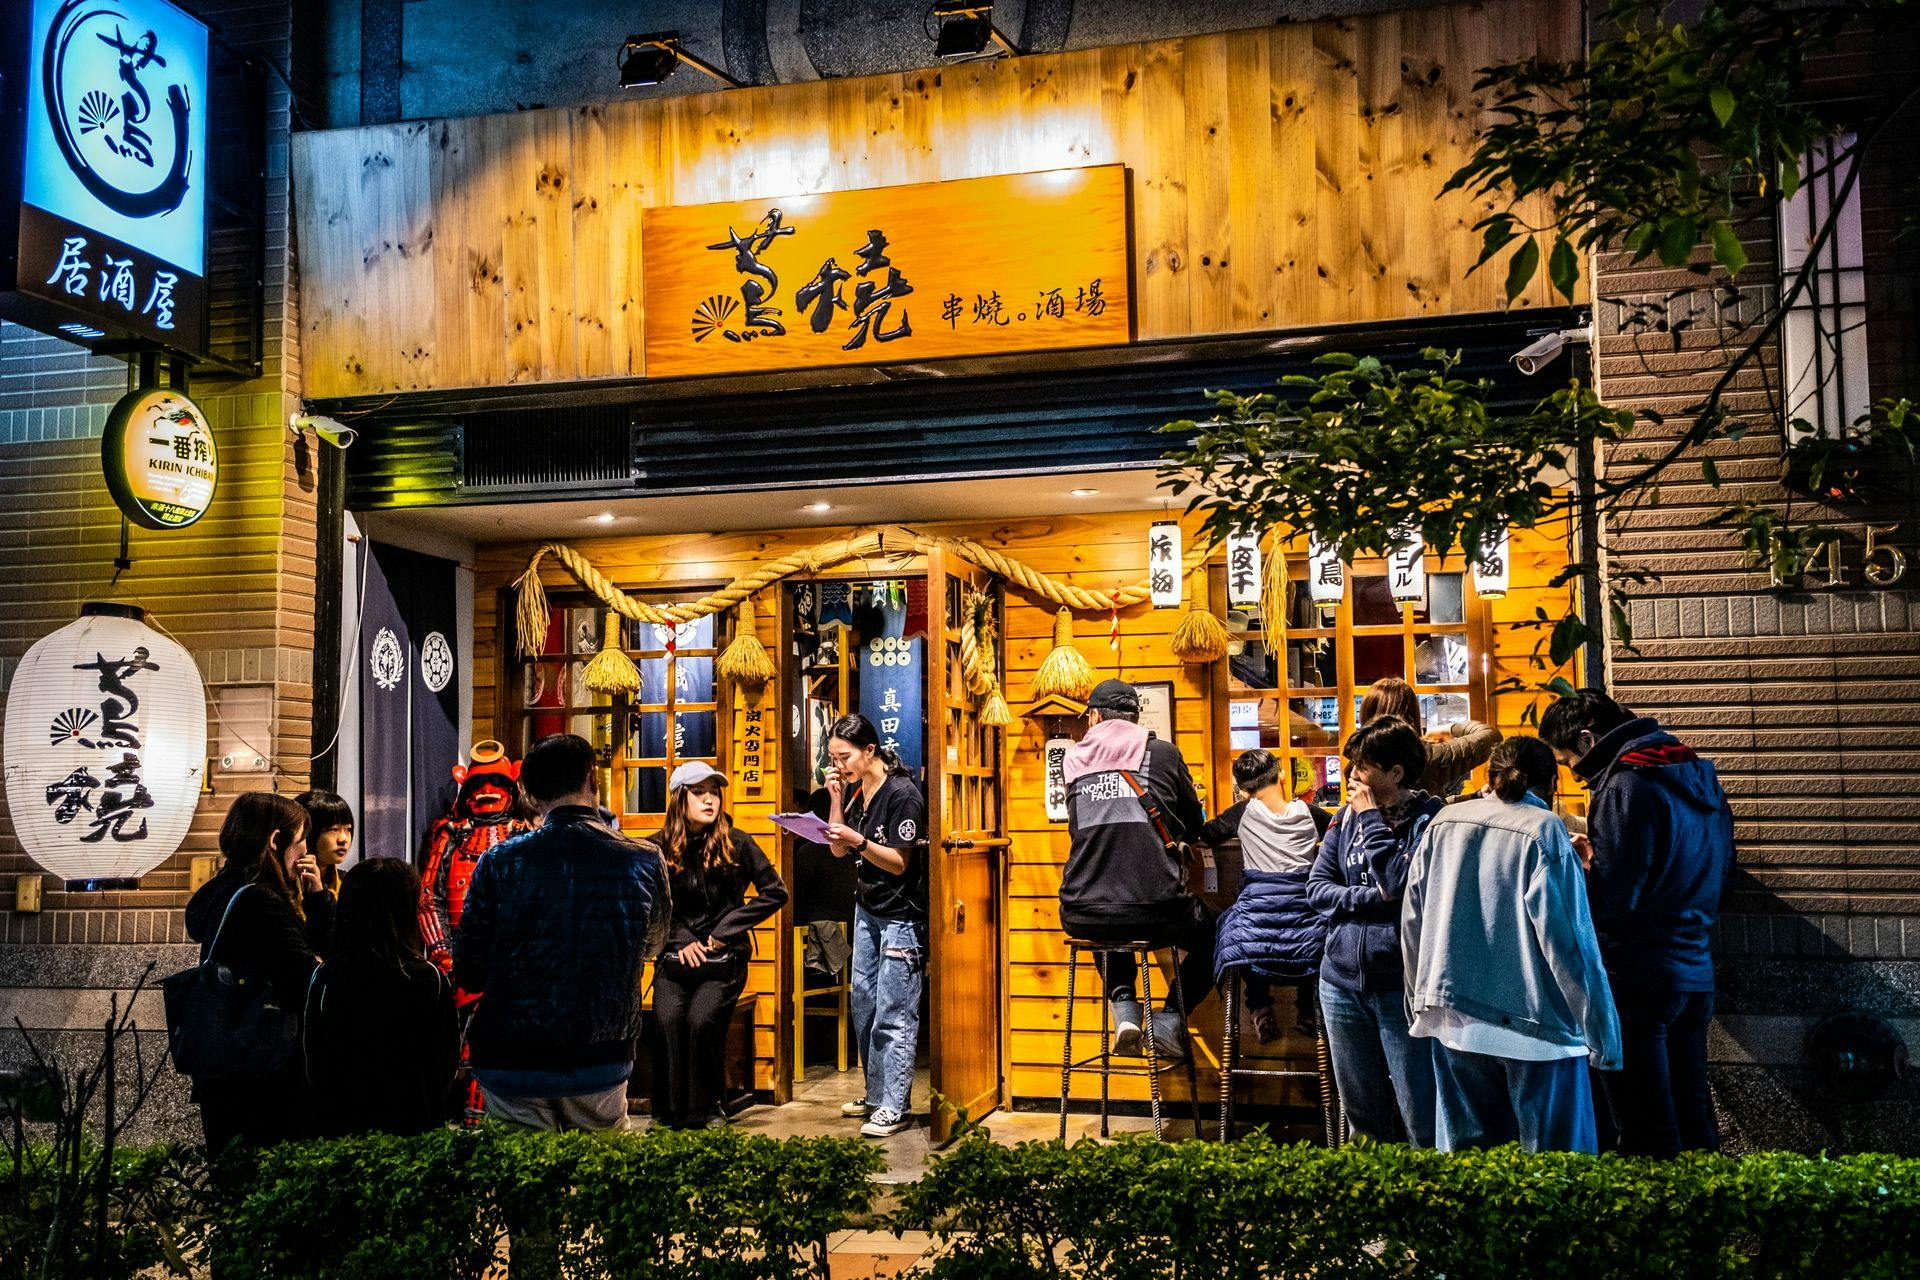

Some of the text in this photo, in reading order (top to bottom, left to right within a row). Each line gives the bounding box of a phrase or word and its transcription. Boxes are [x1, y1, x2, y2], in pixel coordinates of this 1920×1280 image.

[47, 238, 179, 329] 居酒屋
[149, 459, 183, 474] KIRIN
[1768, 523, 1907, 588] 145
[1098, 772, 1119, 784] THE
[1081, 781, 1119, 795] NORTH
[1091, 790, 1118, 802] FACE
